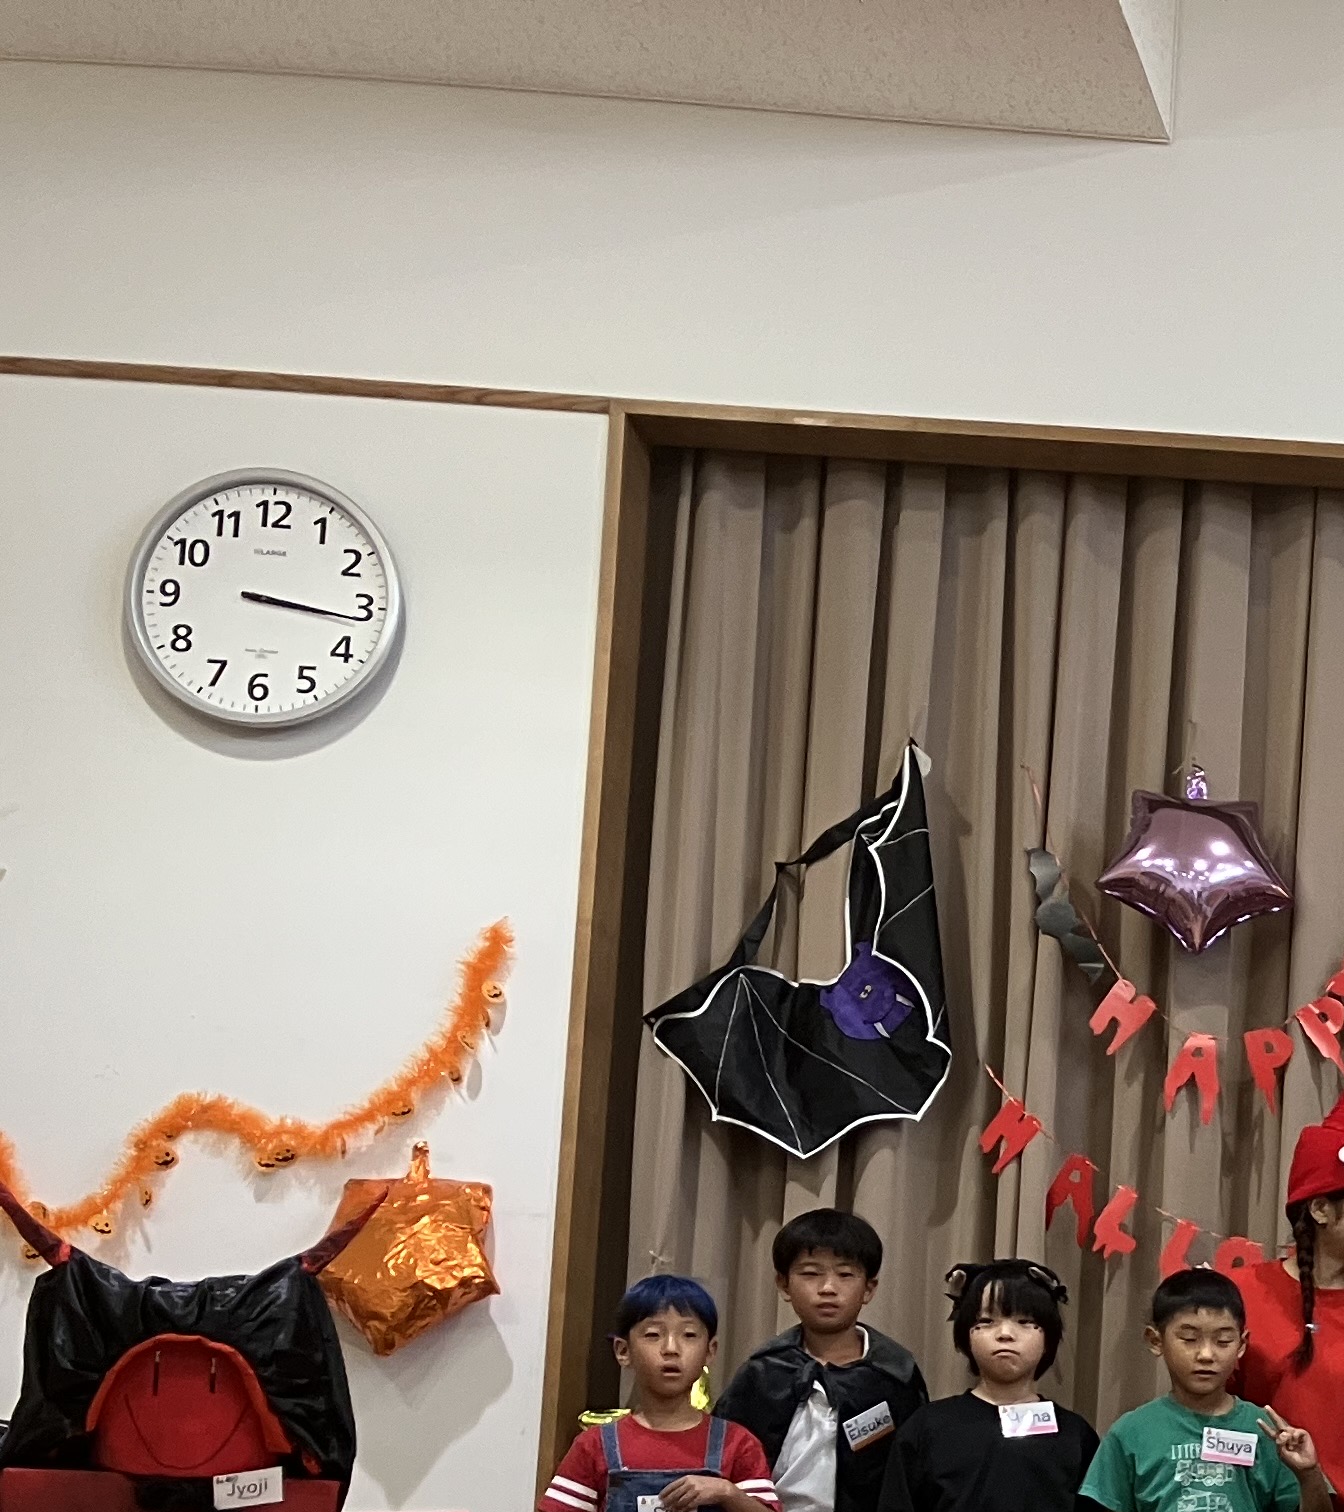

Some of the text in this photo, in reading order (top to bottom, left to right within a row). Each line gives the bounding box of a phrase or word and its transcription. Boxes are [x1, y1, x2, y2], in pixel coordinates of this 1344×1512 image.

[211, 509, 241, 538] 11
[256, 500, 292, 529] 12
[313, 517, 328, 545] 1
[174, 537, 210, 567] 10
[341, 548, 362, 578] 2
[159, 578, 181, 607] 9
[354, 593, 374, 622] 3
[170, 623, 193, 652] 8
[330, 635, 353, 663] 4
[206, 658, 228, 687] 7
[247, 673, 269, 701] 6
[296, 665, 317, 694] 5
[848, 1415, 891, 1441] Eisuke
[1205, 1436, 1253, 1456] Shuya
[227, 1477, 269, 1500] Jyoji
